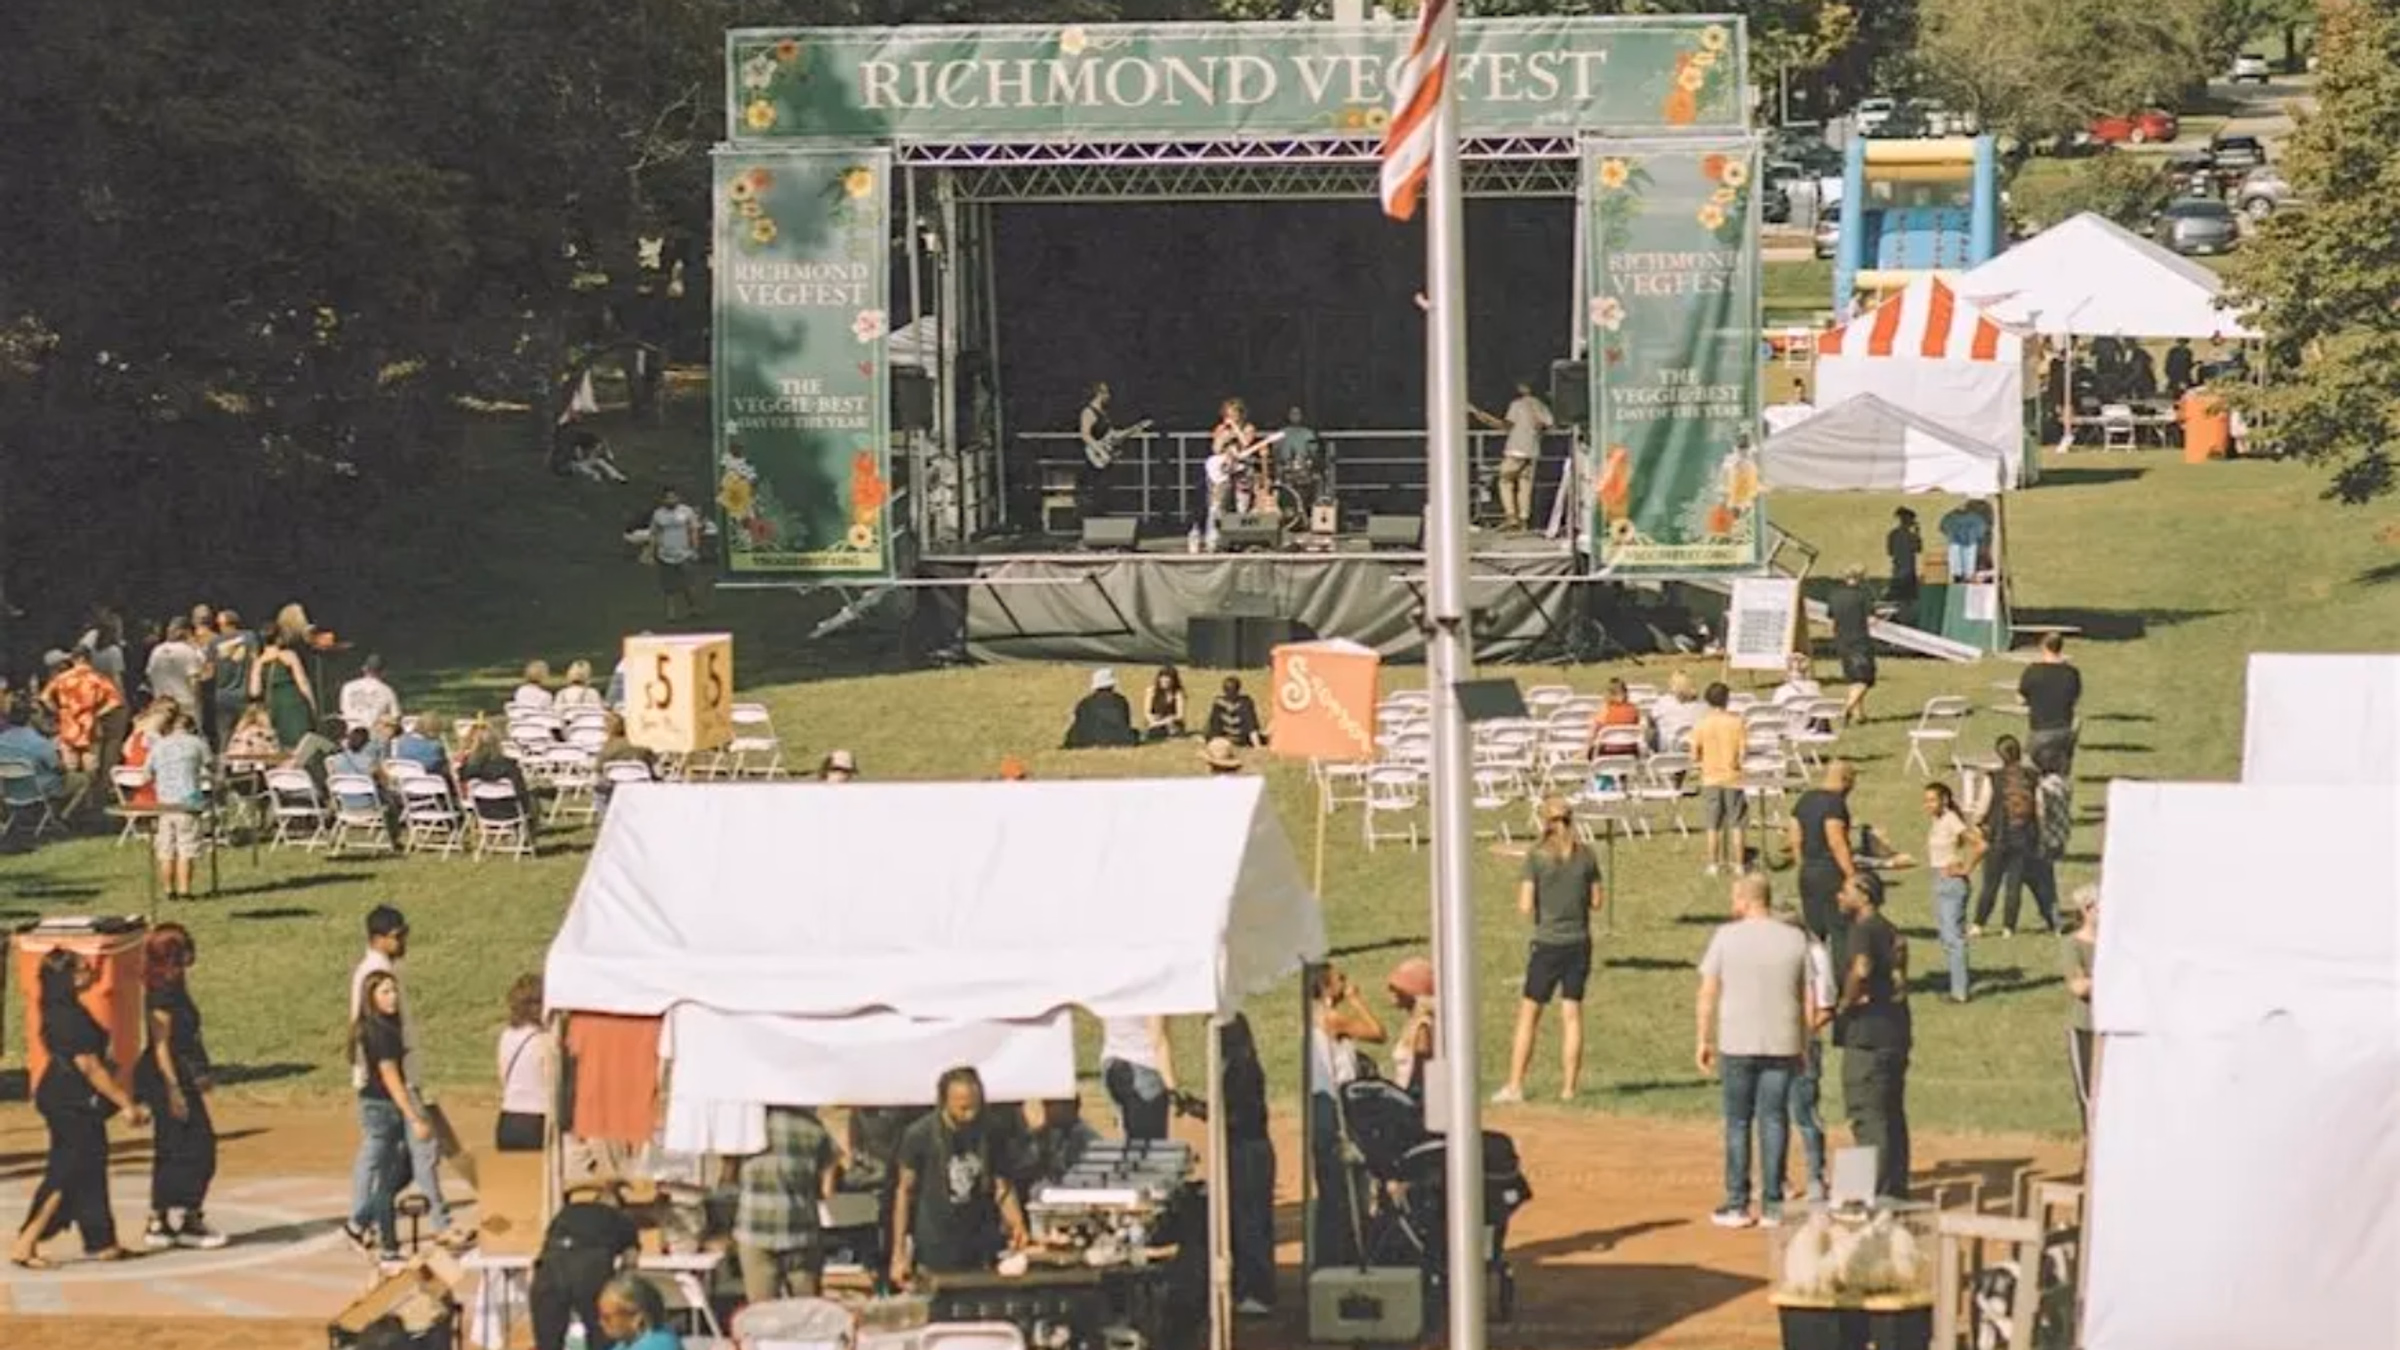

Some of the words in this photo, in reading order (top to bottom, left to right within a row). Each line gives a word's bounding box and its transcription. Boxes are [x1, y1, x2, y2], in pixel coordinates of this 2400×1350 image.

[859, 54, 1279, 110] RICHMOND
[735, 262, 869, 280] RICHMOND
[736, 282, 869, 306] VEGFEST
[779, 378, 823, 395] THE
